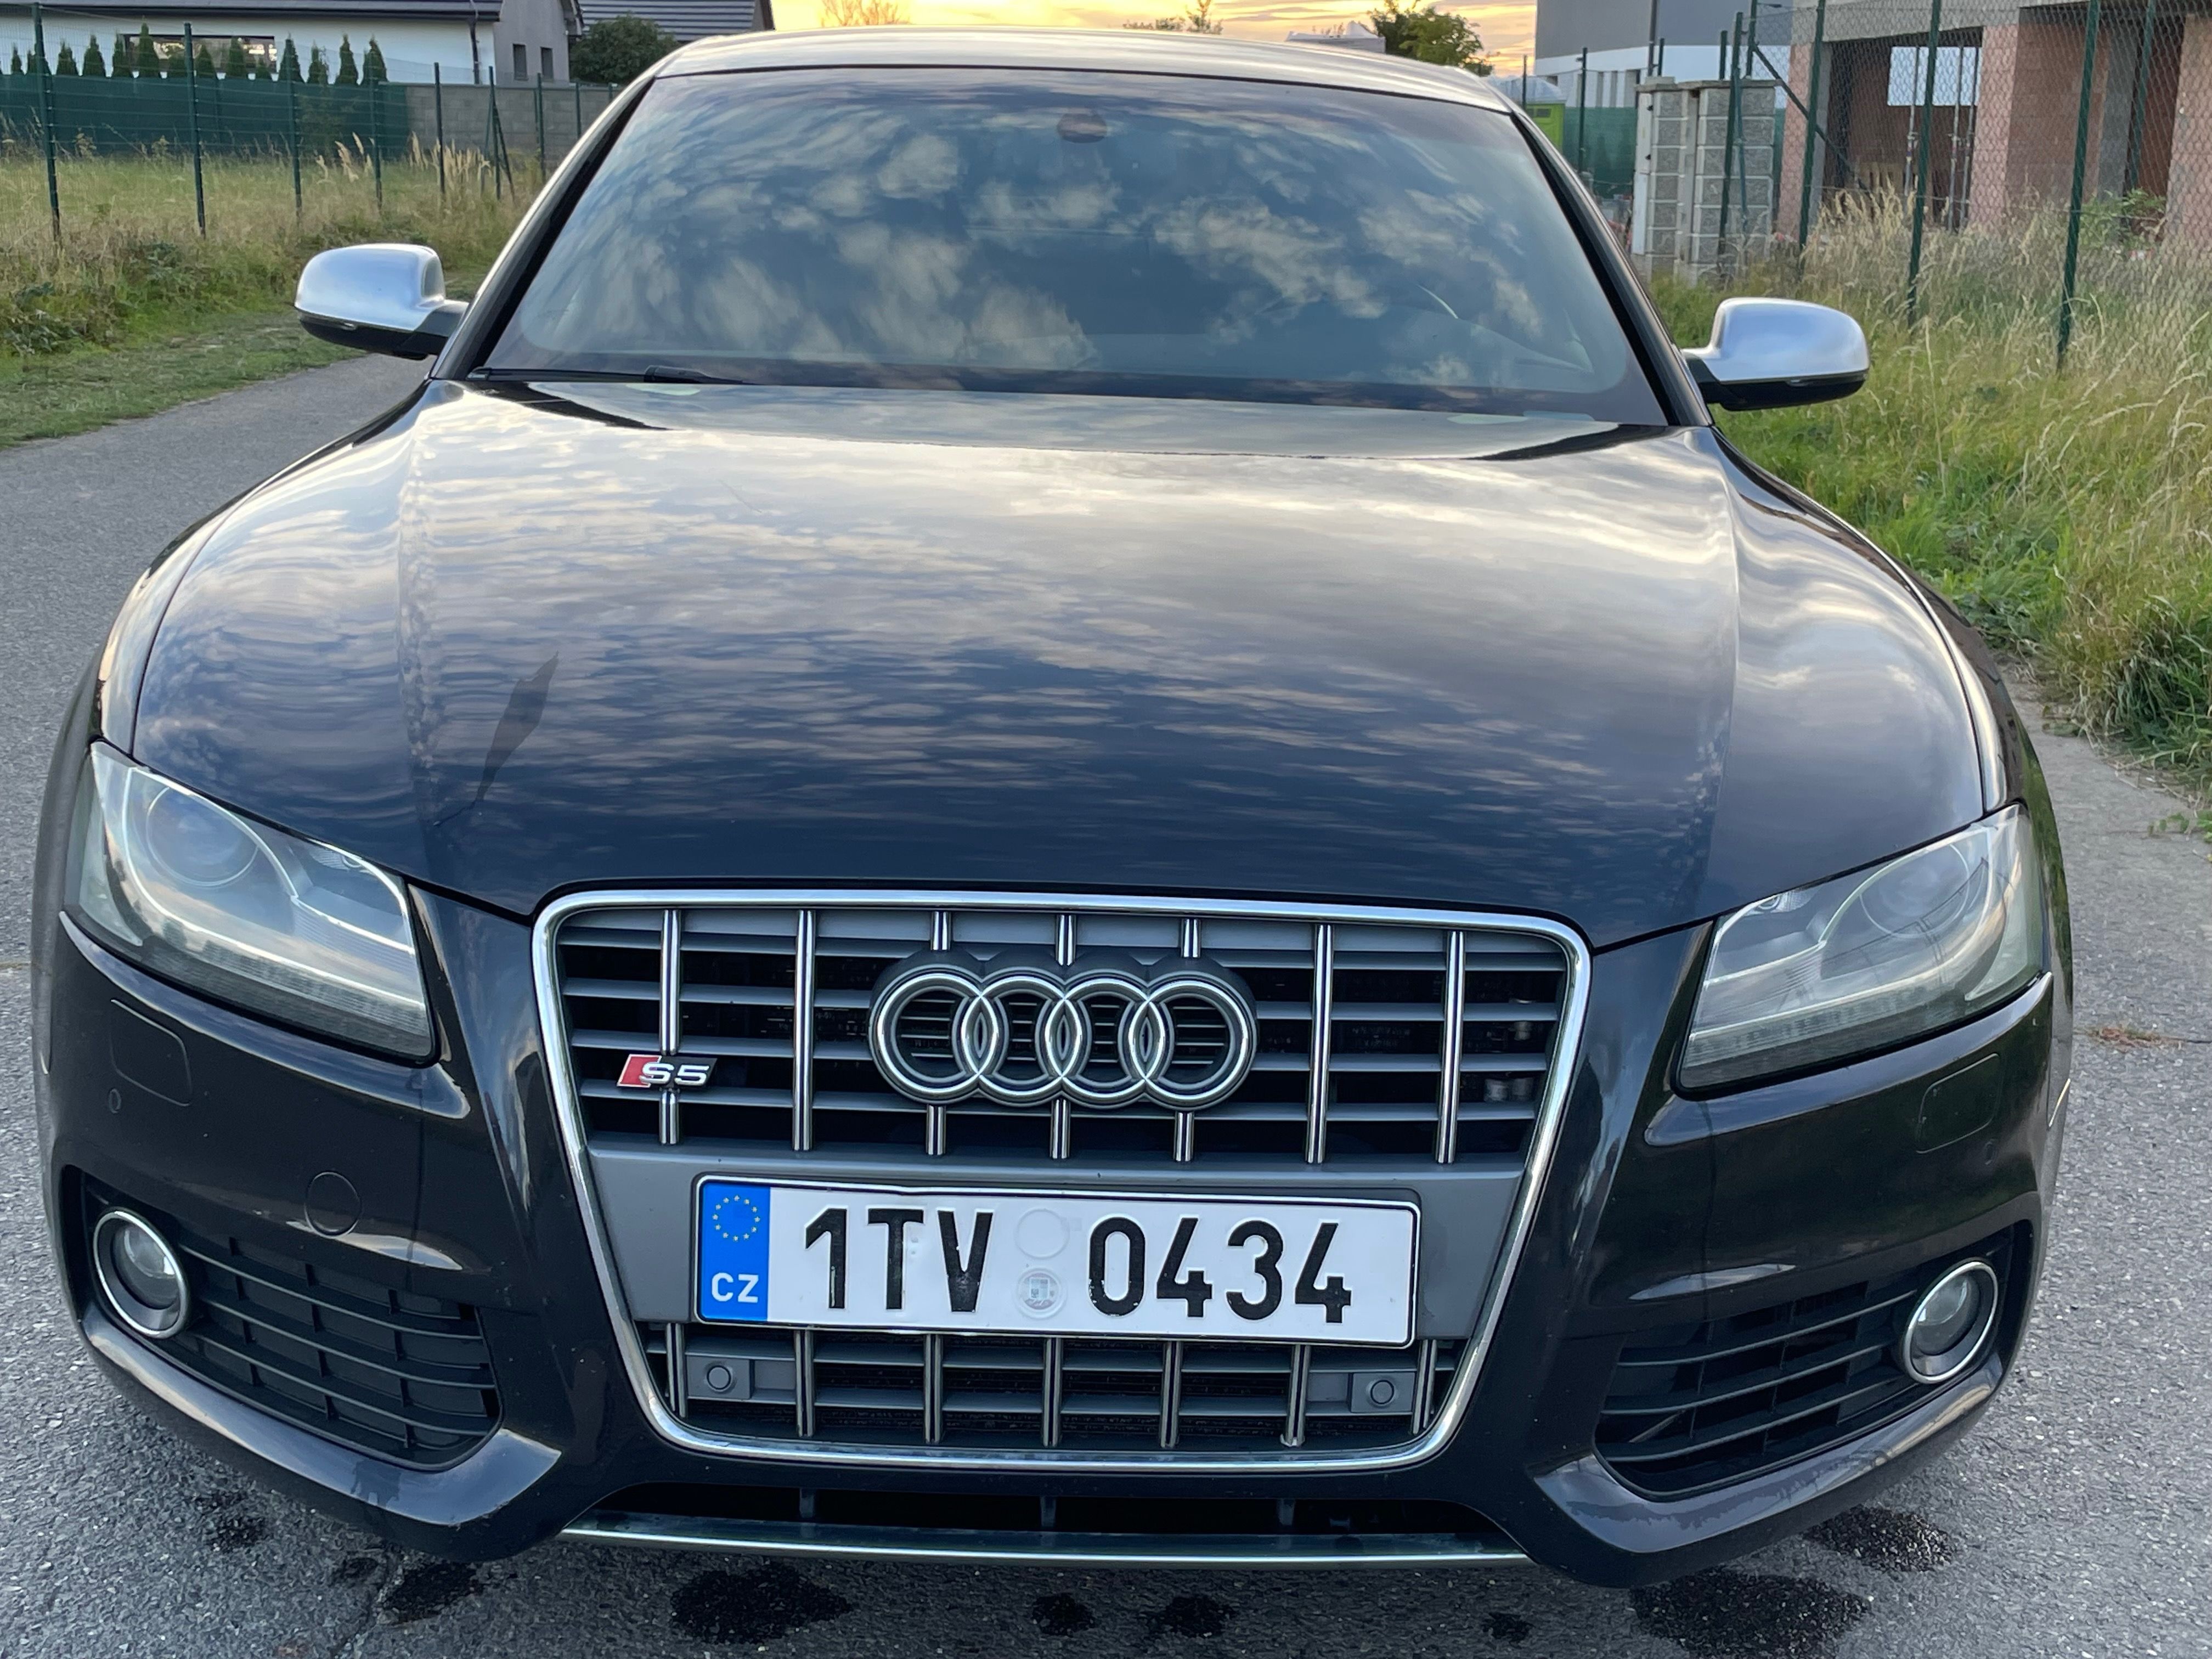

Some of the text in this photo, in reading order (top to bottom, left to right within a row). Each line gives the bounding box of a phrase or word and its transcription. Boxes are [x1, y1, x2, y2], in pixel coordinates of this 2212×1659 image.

[639, 1062, 709, 1086] S5
[805, 1207, 1352, 1323] 1TV 0434
[712, 1272, 759, 1303] CZ
